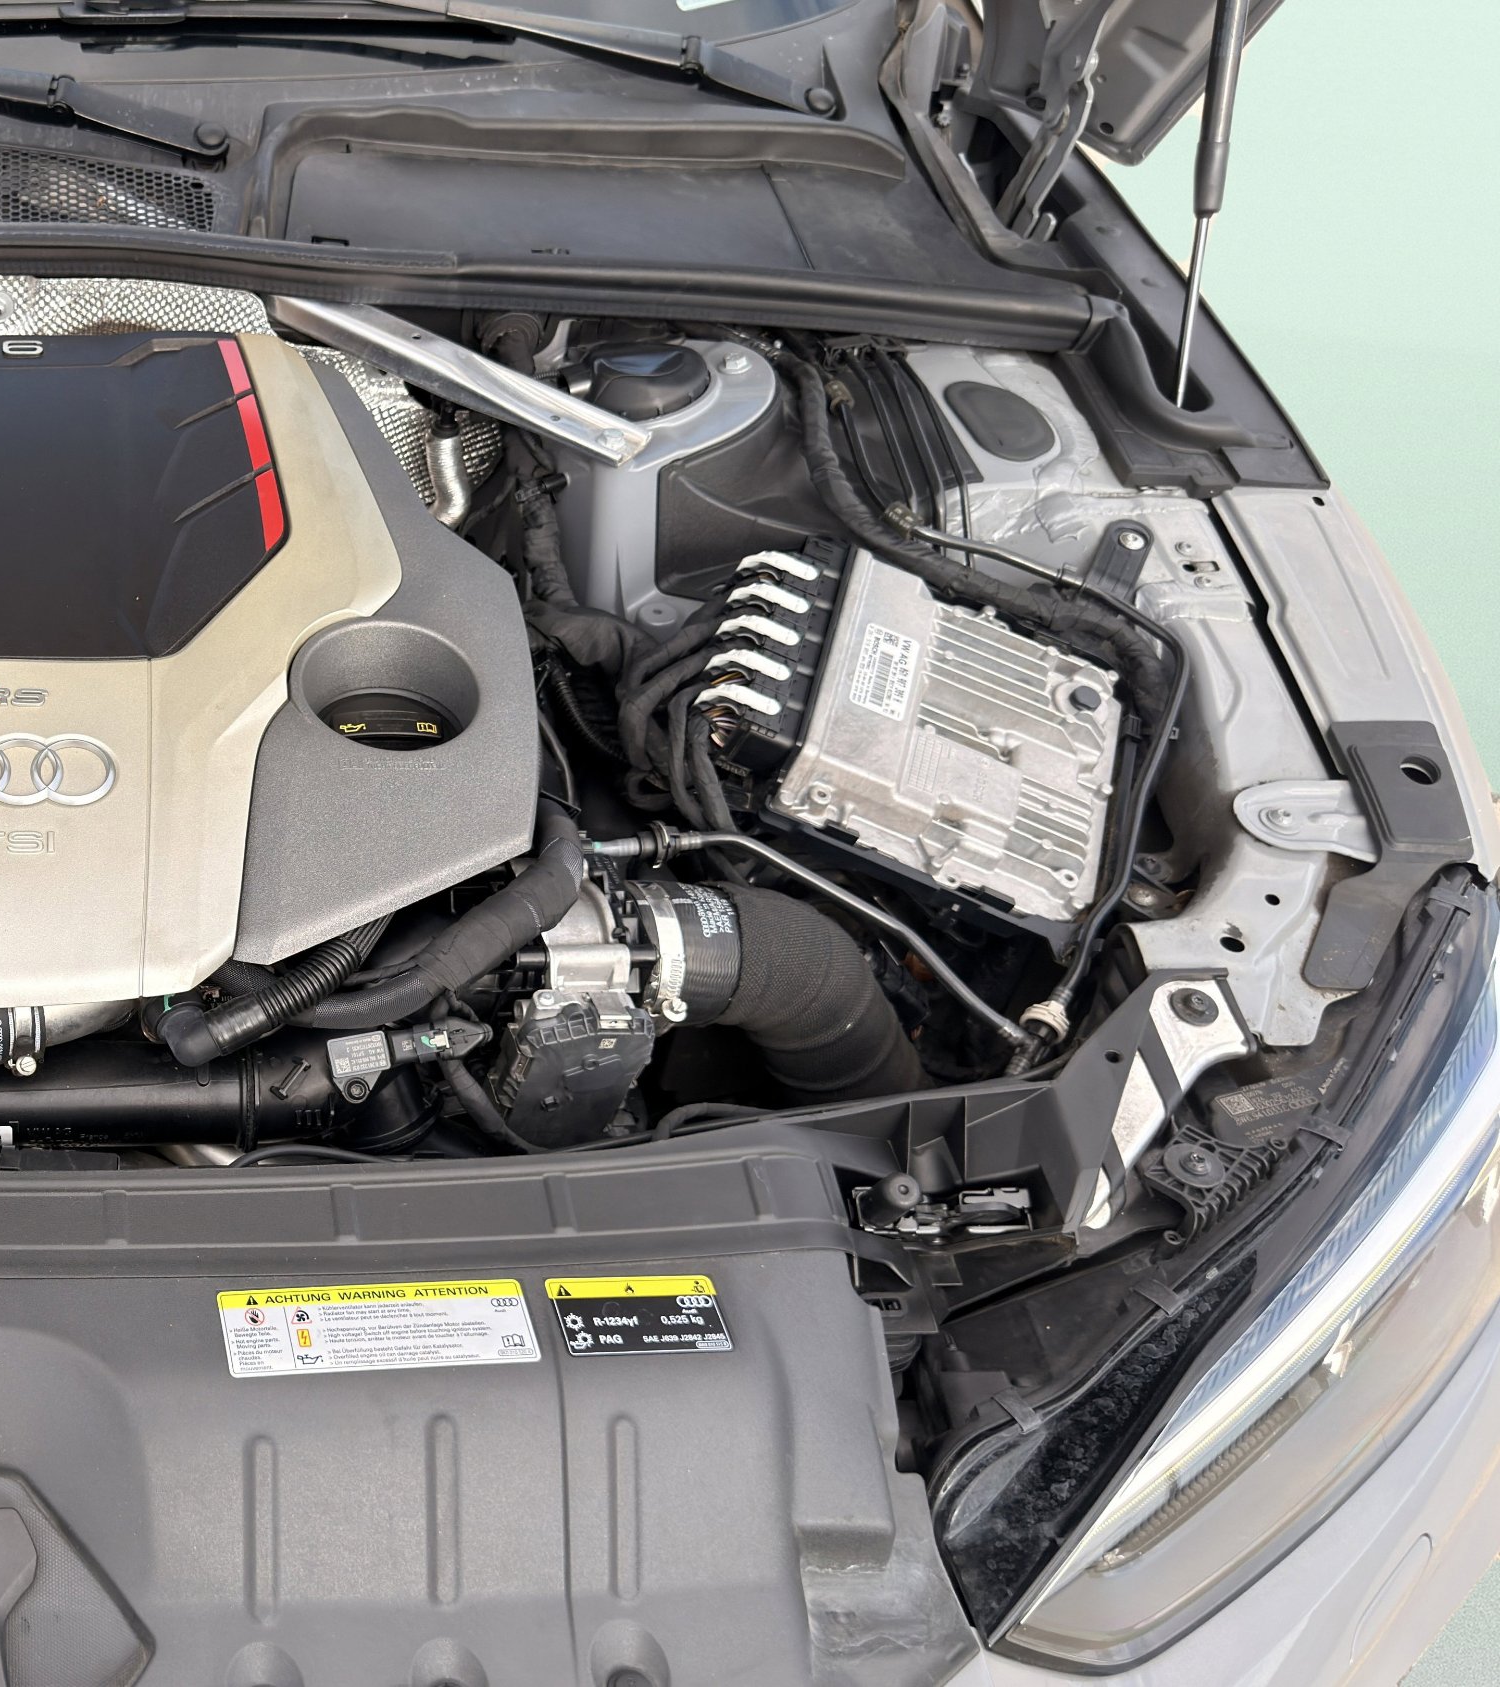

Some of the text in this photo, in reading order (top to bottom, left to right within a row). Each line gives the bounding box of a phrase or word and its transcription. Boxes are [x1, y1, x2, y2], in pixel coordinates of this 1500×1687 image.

[265, 1286, 489, 1304] ACHTUNG WARNING ATTENTION
[593, 1316, 640, 1328] R-1234yf
[660, 1315, 705, 1325] 0,525 kg
[599, 1334, 624, 1344] PAG
[642, 1335, 660, 1343] SAE
